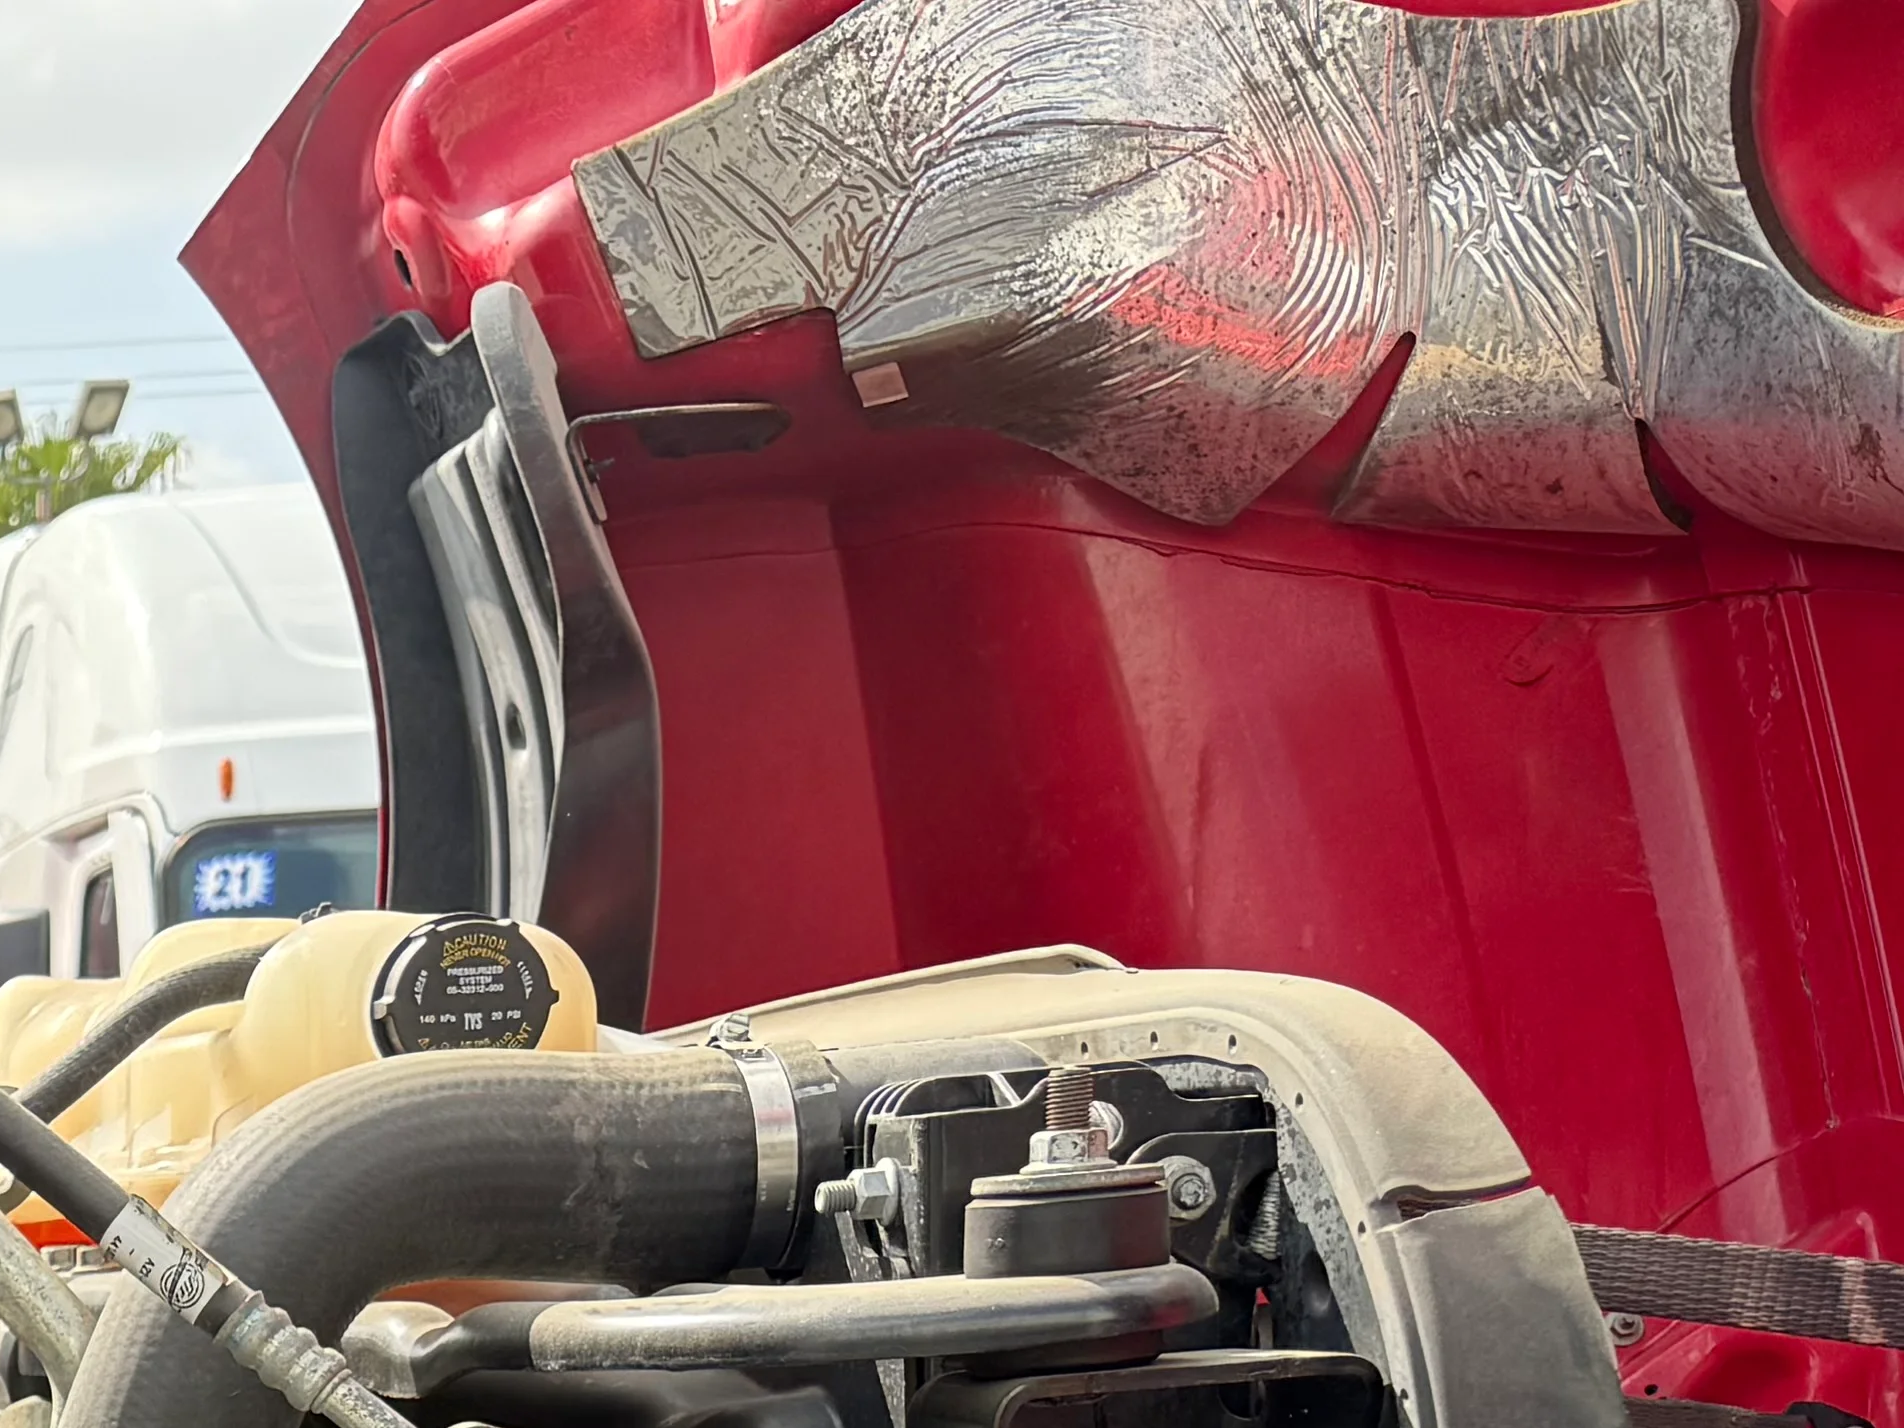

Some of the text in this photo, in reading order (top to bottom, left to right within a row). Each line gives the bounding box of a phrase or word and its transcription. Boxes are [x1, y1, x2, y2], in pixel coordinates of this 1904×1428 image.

[212, 864, 250, 897] 21
[454, 933, 507, 951] CAUTION
[446, 965, 504, 977] PRESSURIZED
[458, 975, 493, 985] SYSTEM
[420, 1015, 436, 1024] 140
[463, 1012, 483, 1031] TVS
